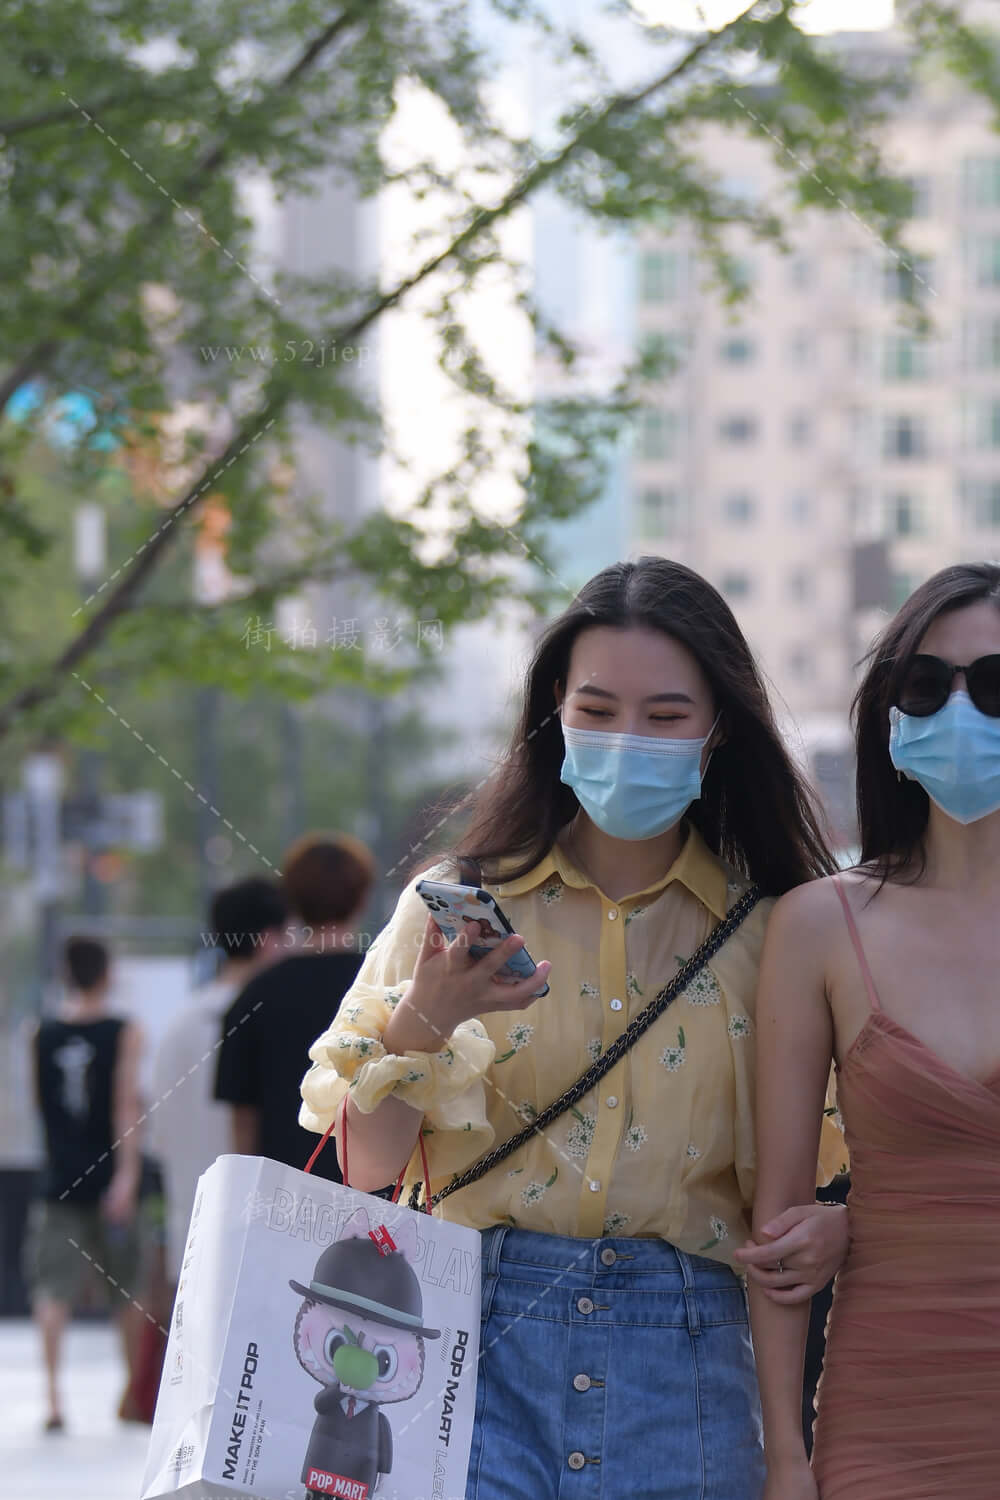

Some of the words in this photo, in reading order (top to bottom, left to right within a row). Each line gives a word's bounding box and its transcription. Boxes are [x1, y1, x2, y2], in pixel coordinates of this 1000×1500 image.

[241, 1342, 259, 1389] POP
[450, 1329, 469, 1378] POP
[236, 1390, 251, 1411] IT
[438, 1379, 459, 1447] MART
[222, 1412, 247, 1480] MAKE
[309, 1471, 333, 1490] POP
[334, 1479, 365, 1500] MART
